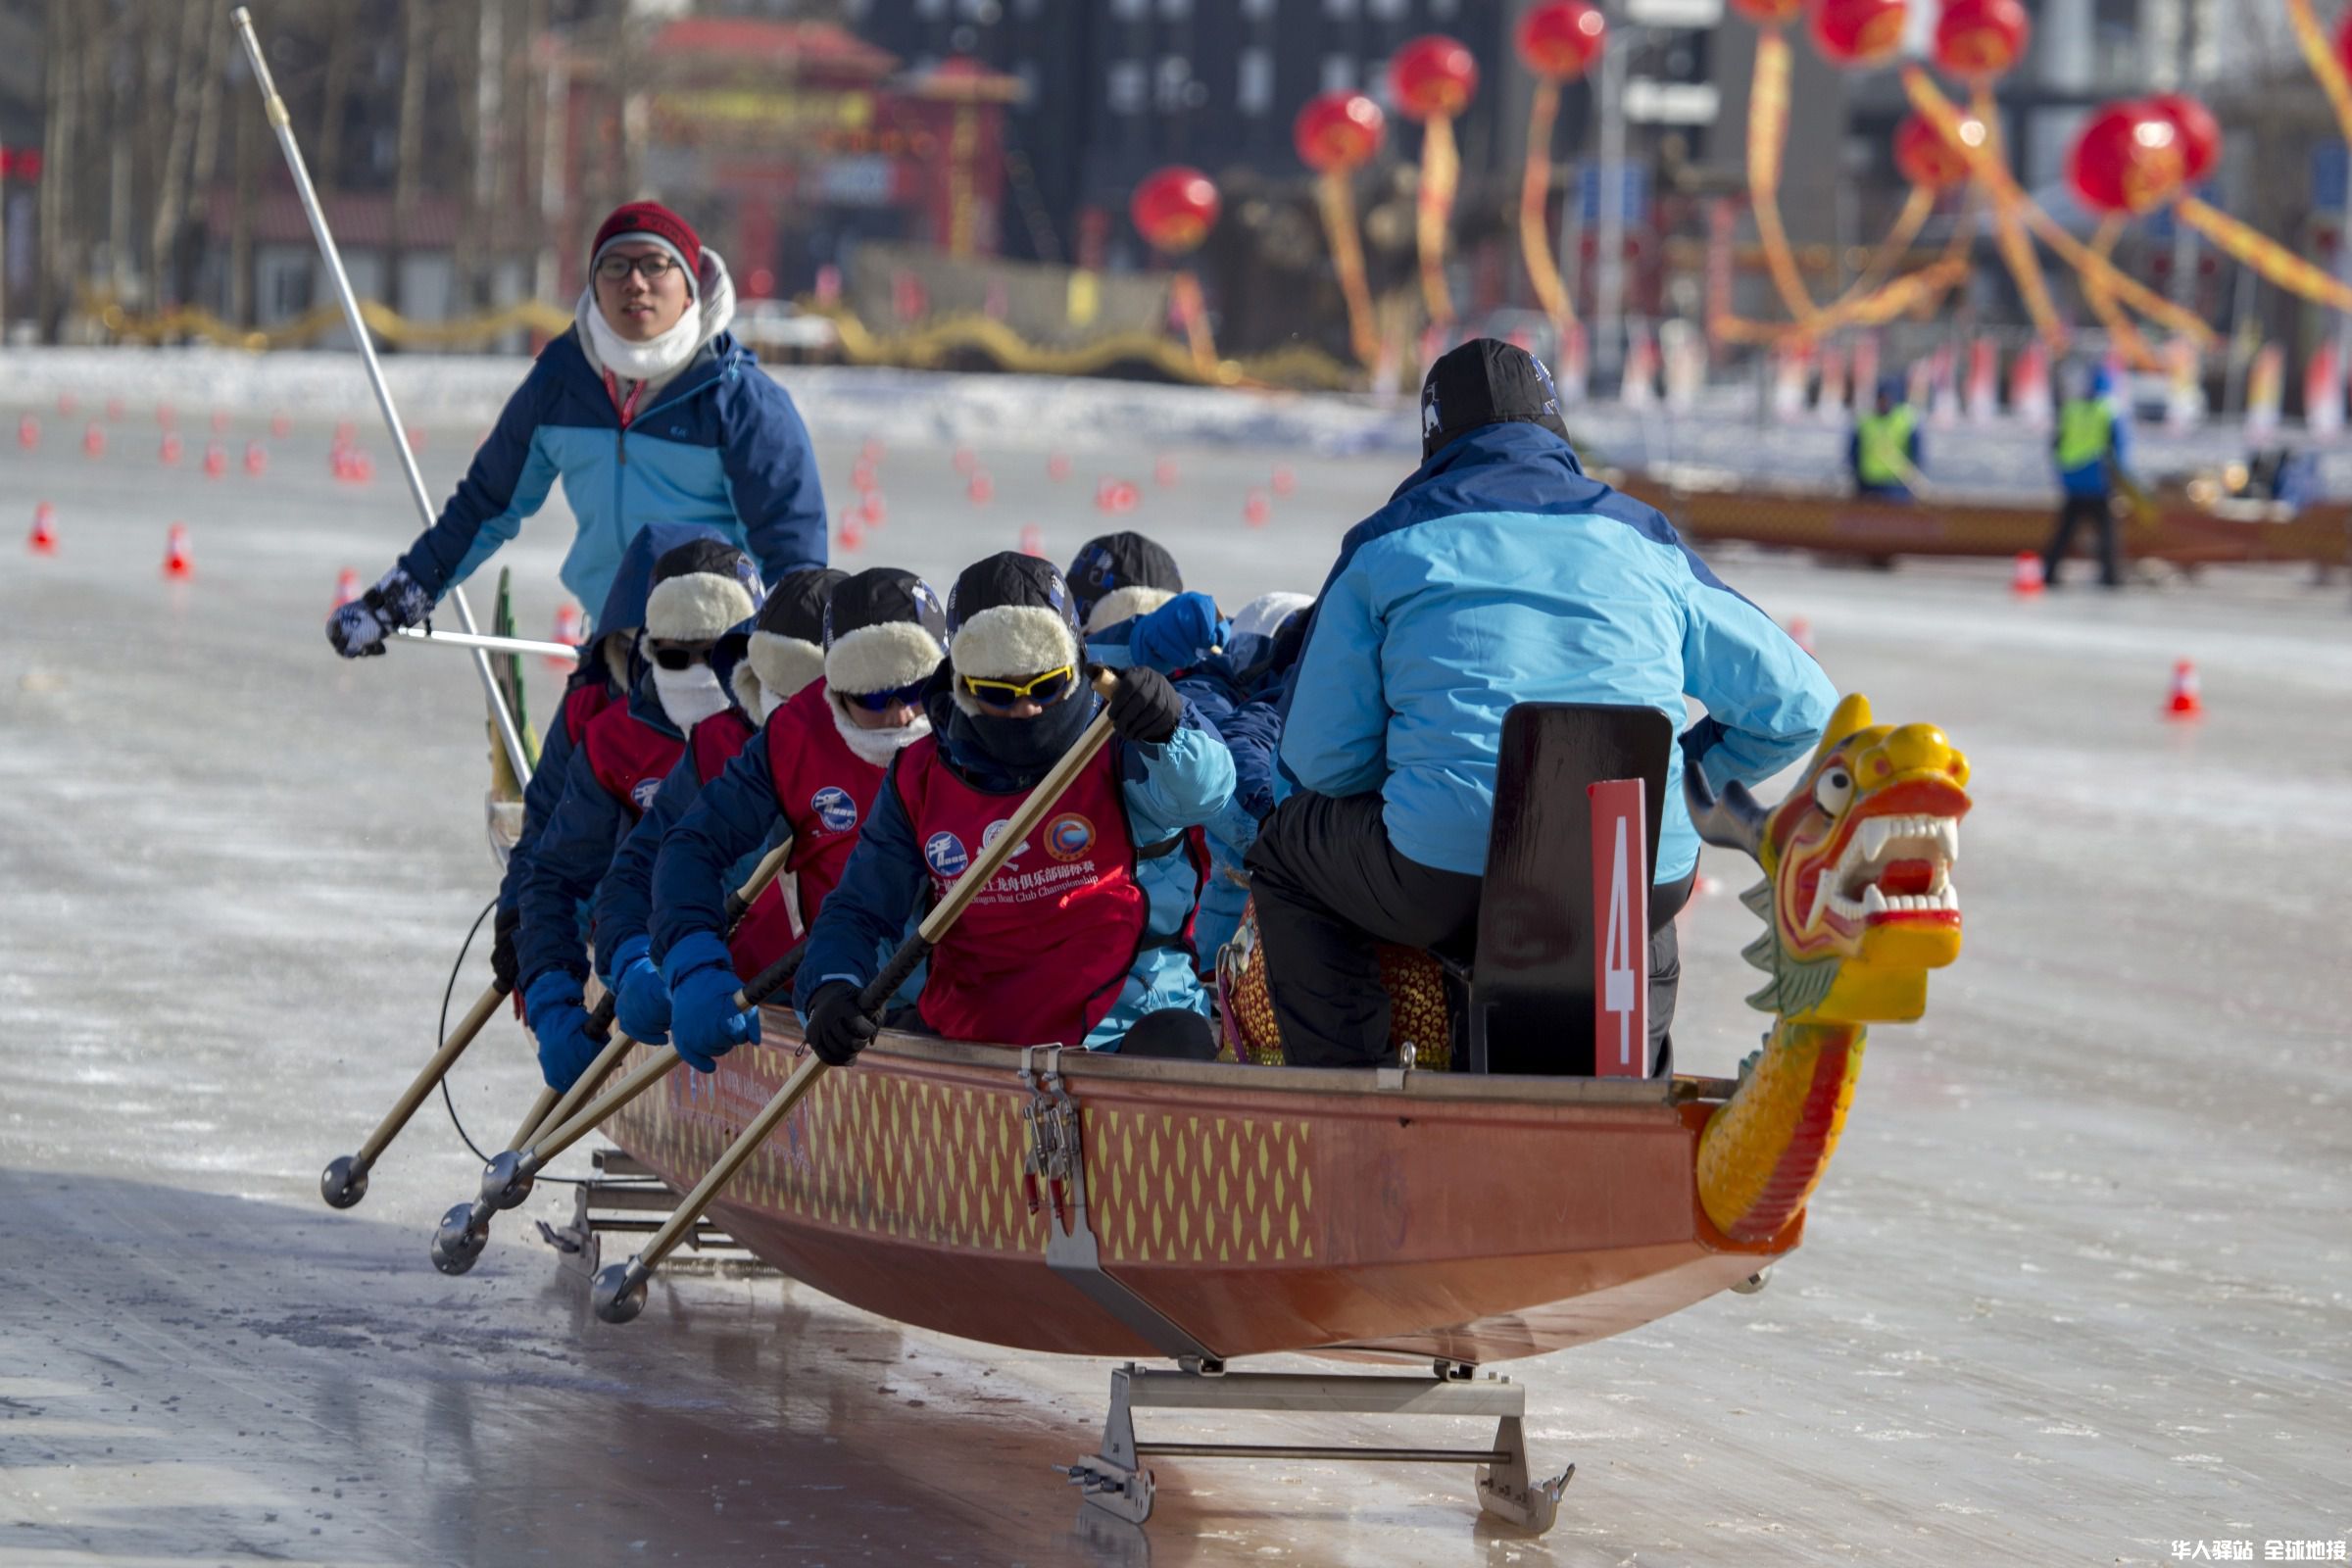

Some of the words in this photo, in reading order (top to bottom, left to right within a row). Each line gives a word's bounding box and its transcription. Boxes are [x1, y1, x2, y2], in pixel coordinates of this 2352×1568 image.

[1015, 890, 1037, 903] Club
[1038, 874, 1099, 898] Championship
[1605, 815, 1635, 1064] 4
